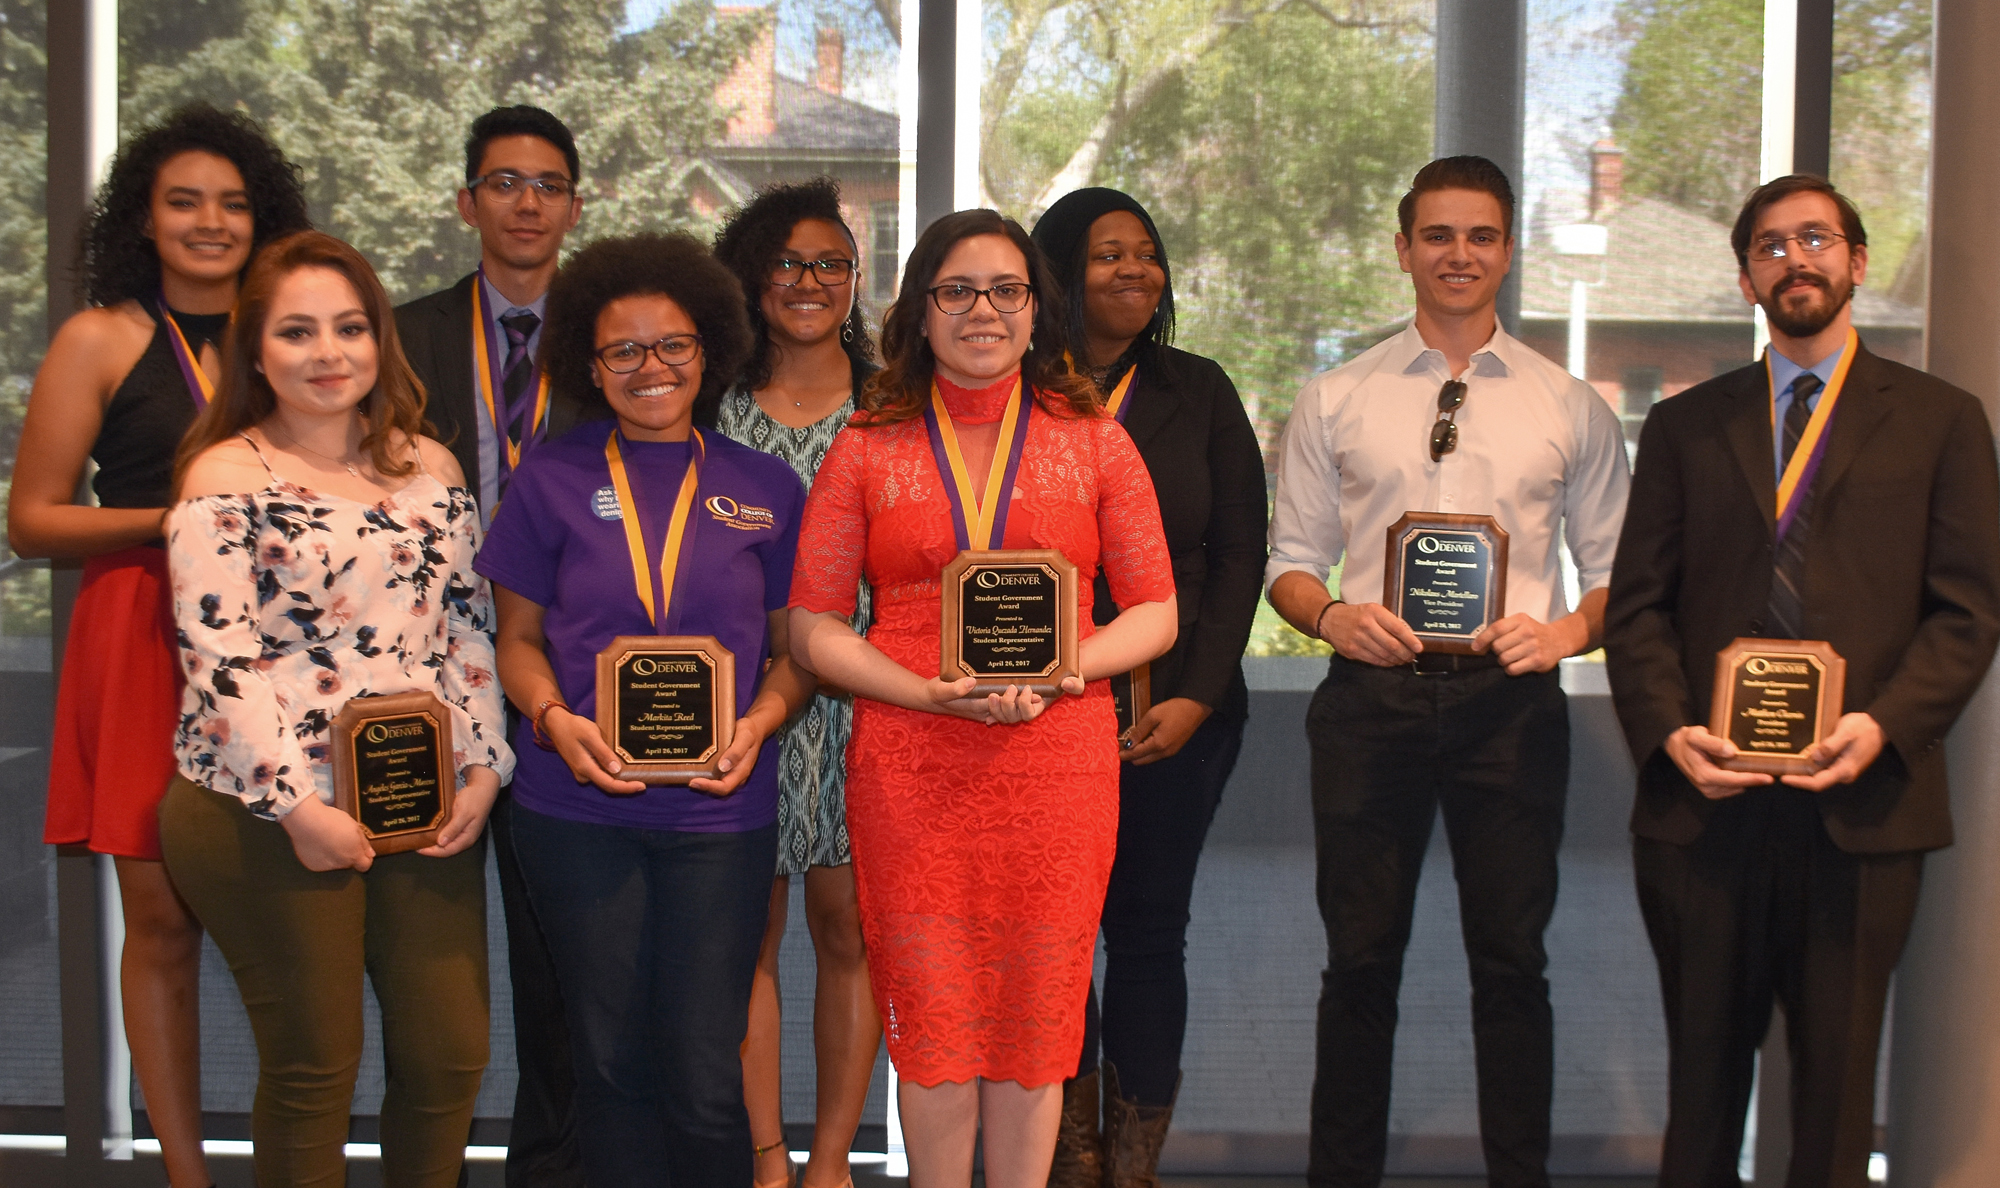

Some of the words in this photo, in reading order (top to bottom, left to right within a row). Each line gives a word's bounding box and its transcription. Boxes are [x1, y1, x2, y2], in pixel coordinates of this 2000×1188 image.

[740, 513, 775, 525] DENVER
[1439, 543, 1476, 553] DENVER
[1438, 560, 1478, 568] Government
[1001, 577, 1041, 585] DENVER
[966, 625, 991, 634] Victoria
[1019, 624, 1052, 634] Hernandez
[998, 637, 1045, 645] Representative
[657, 664, 699, 673] DENVER
[637, 713, 673, 722] Markita
[674, 713, 695, 722] Reed
[388, 726, 424, 739] DENVER
[366, 750, 390, 758] Student
[390, 745, 427, 755] Government
[391, 790, 431, 801] Representative
[382, 818, 398, 827] April
